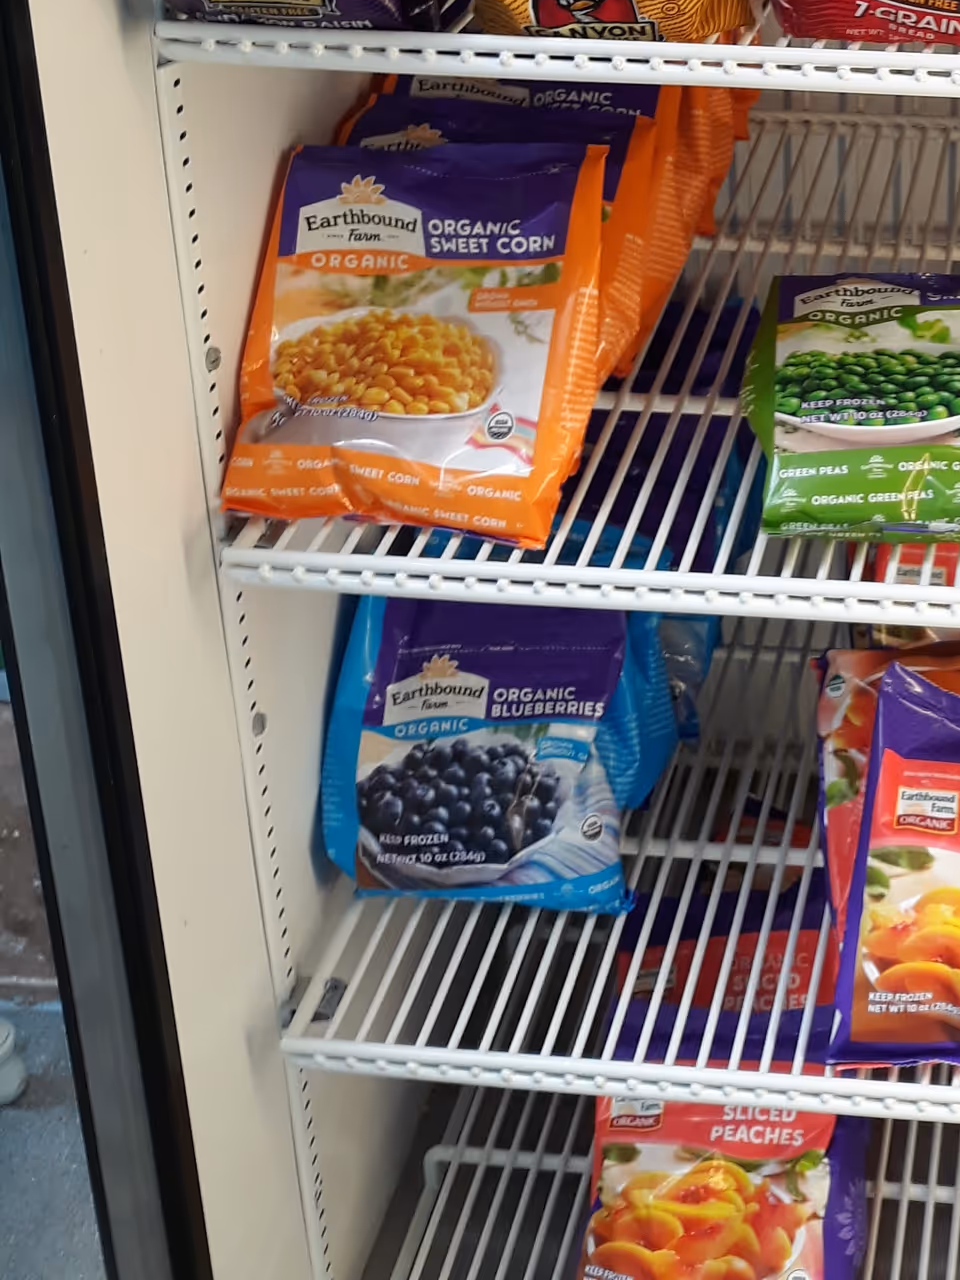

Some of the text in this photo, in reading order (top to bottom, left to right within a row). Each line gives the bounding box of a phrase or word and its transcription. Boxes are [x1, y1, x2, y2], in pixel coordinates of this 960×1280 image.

[417, 78, 614, 108] Earthbound ORGANIC
[303, 208, 419, 234] Earthbound
[427, 218, 521, 236] ORGANIC
[347, 228, 382, 243] Farm
[430, 235, 556, 254] SWEET CORN
[310, 252, 410, 270] ORGANIC
[798, 284, 915, 306] Earthbound
[807, 307, 903, 326] ORGANIC
[801, 398, 886, 410] KEEP FROZEN
[779, 468, 818, 479] GREEN
[819, 465, 849, 476] PEAS
[897, 460, 949, 472] ORGANIC
[348, 463, 523, 502] SWEET CORN ORGANIC
[811, 493, 865, 506] ORGANIC
[867, 491, 907, 503] GREEN
[906, 489, 934, 501] PEAS
[433, 508, 507, 529] SWEET CORN
[391, 685, 486, 707] Earthbound
[493, 687, 577, 702] ORGANIC
[491, 701, 606, 718] BLUEBERRIES
[394, 718, 470, 738] ORGANIC
[900, 790, 956, 804] Earthbound
[899, 814, 954, 829] ORGANIC
[403, 833, 449, 846] FROZEN
[868, 991, 933, 1002] KEEP FROZEN
[722, 1105, 798, 1123] SLICED
[709, 1124, 805, 1147] PEACHES
